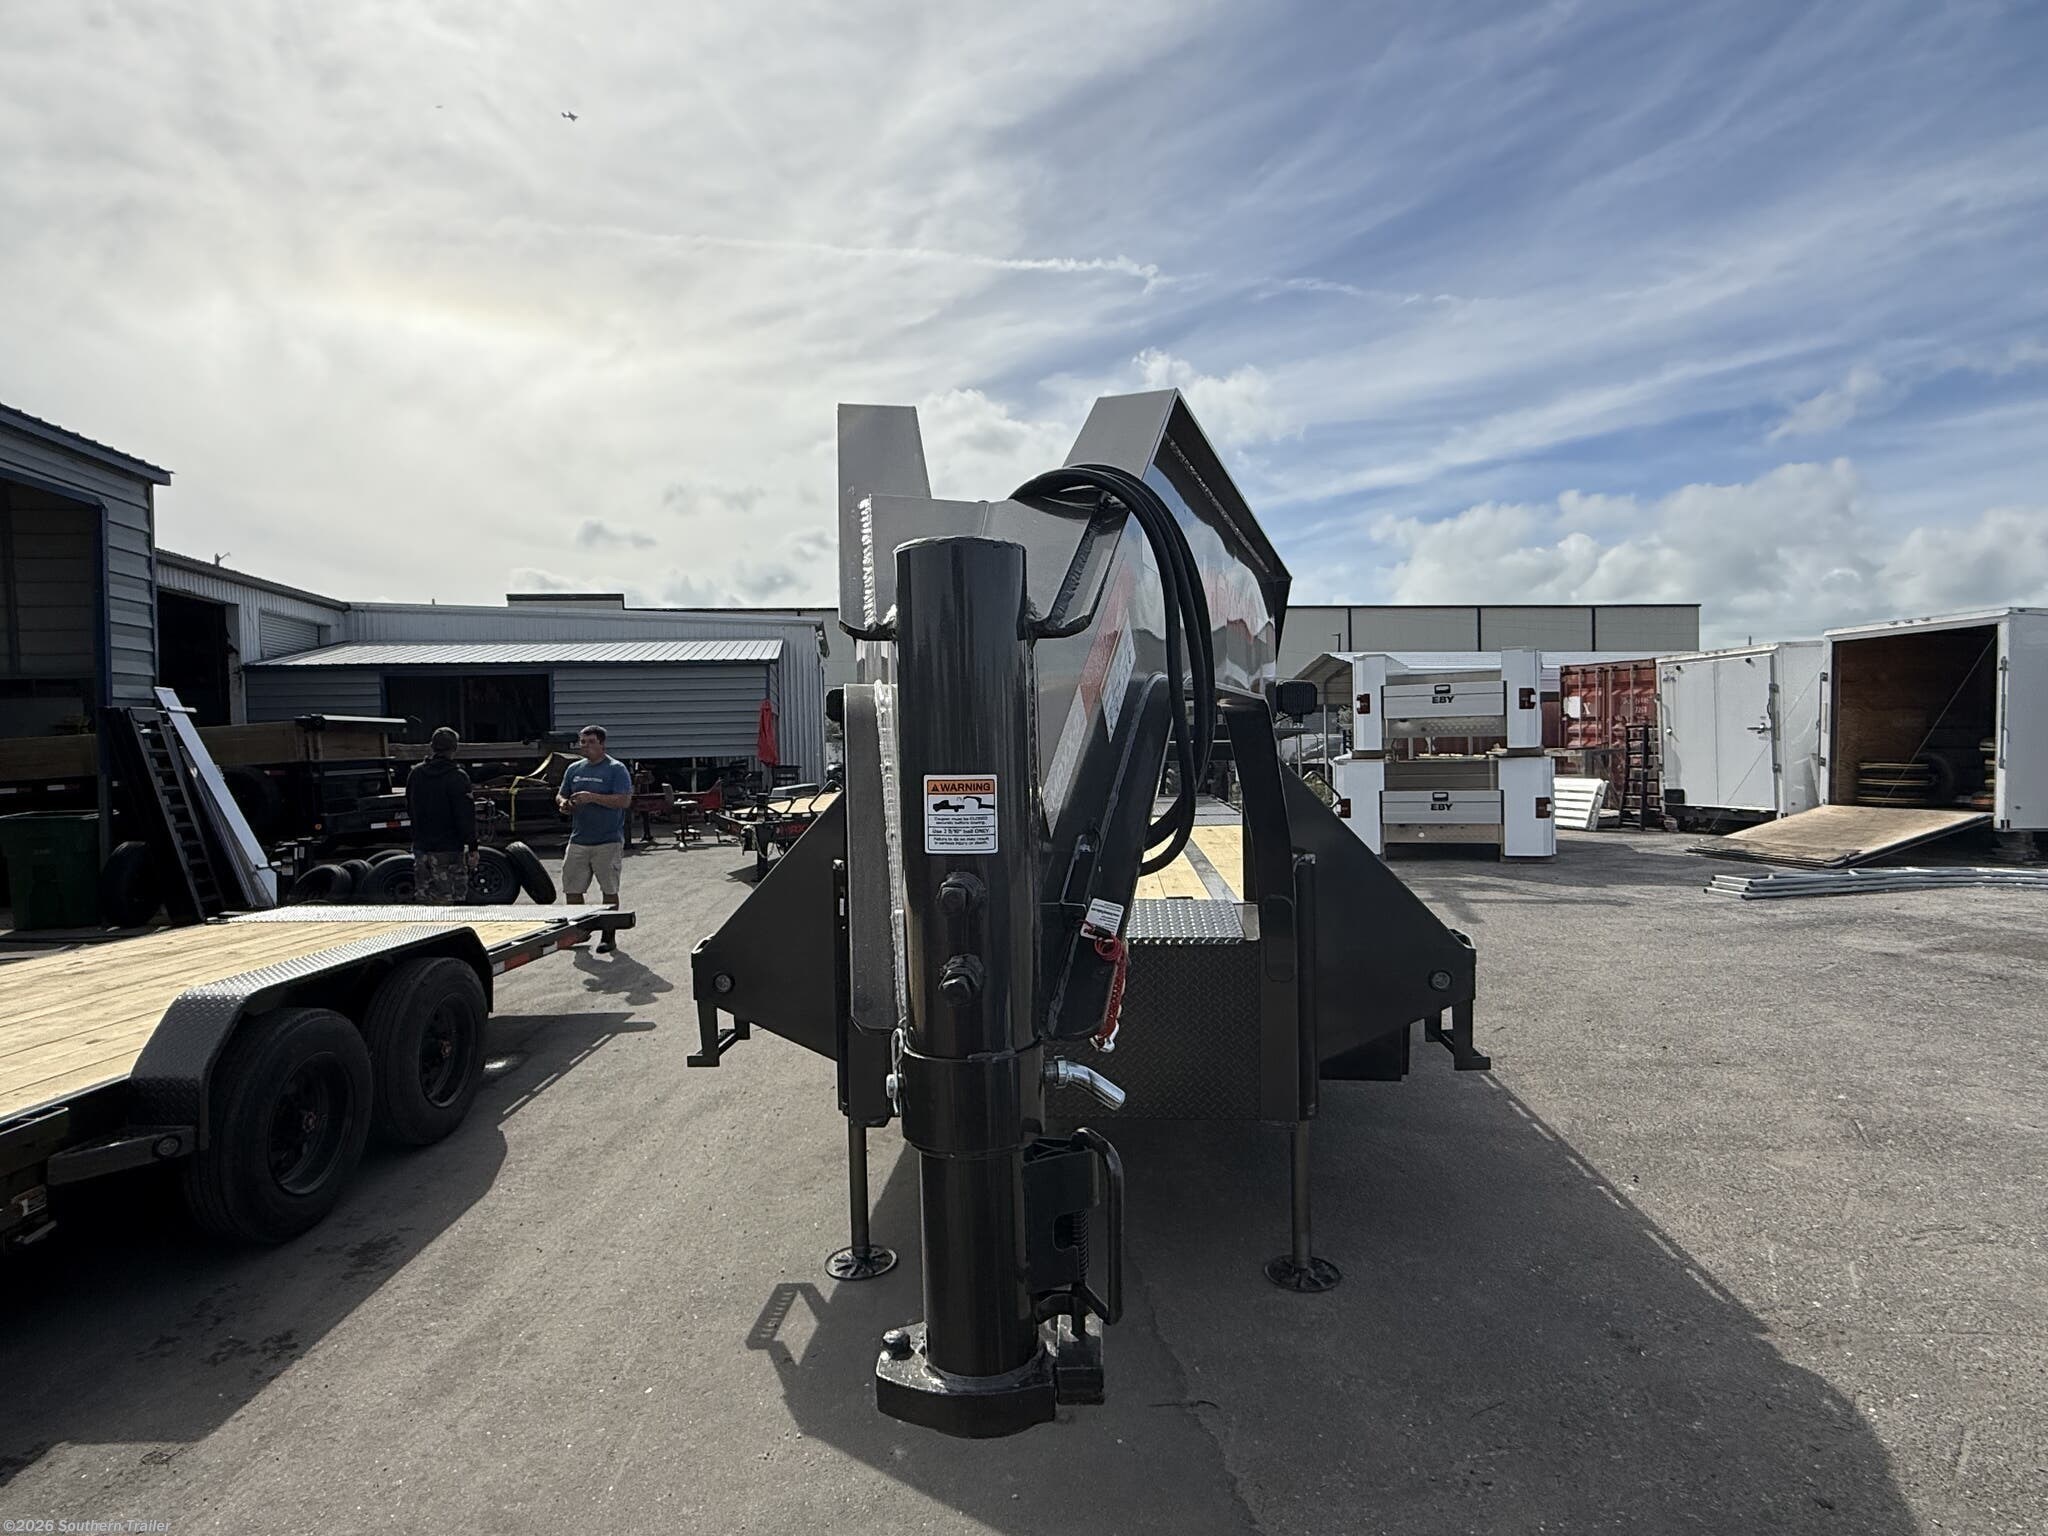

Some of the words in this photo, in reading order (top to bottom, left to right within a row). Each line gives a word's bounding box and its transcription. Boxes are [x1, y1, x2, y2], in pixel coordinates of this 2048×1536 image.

[1431, 695, 1455, 704] EBY
[940, 782, 991, 792] WARNING
[1430, 803, 1453, 811] EBY
